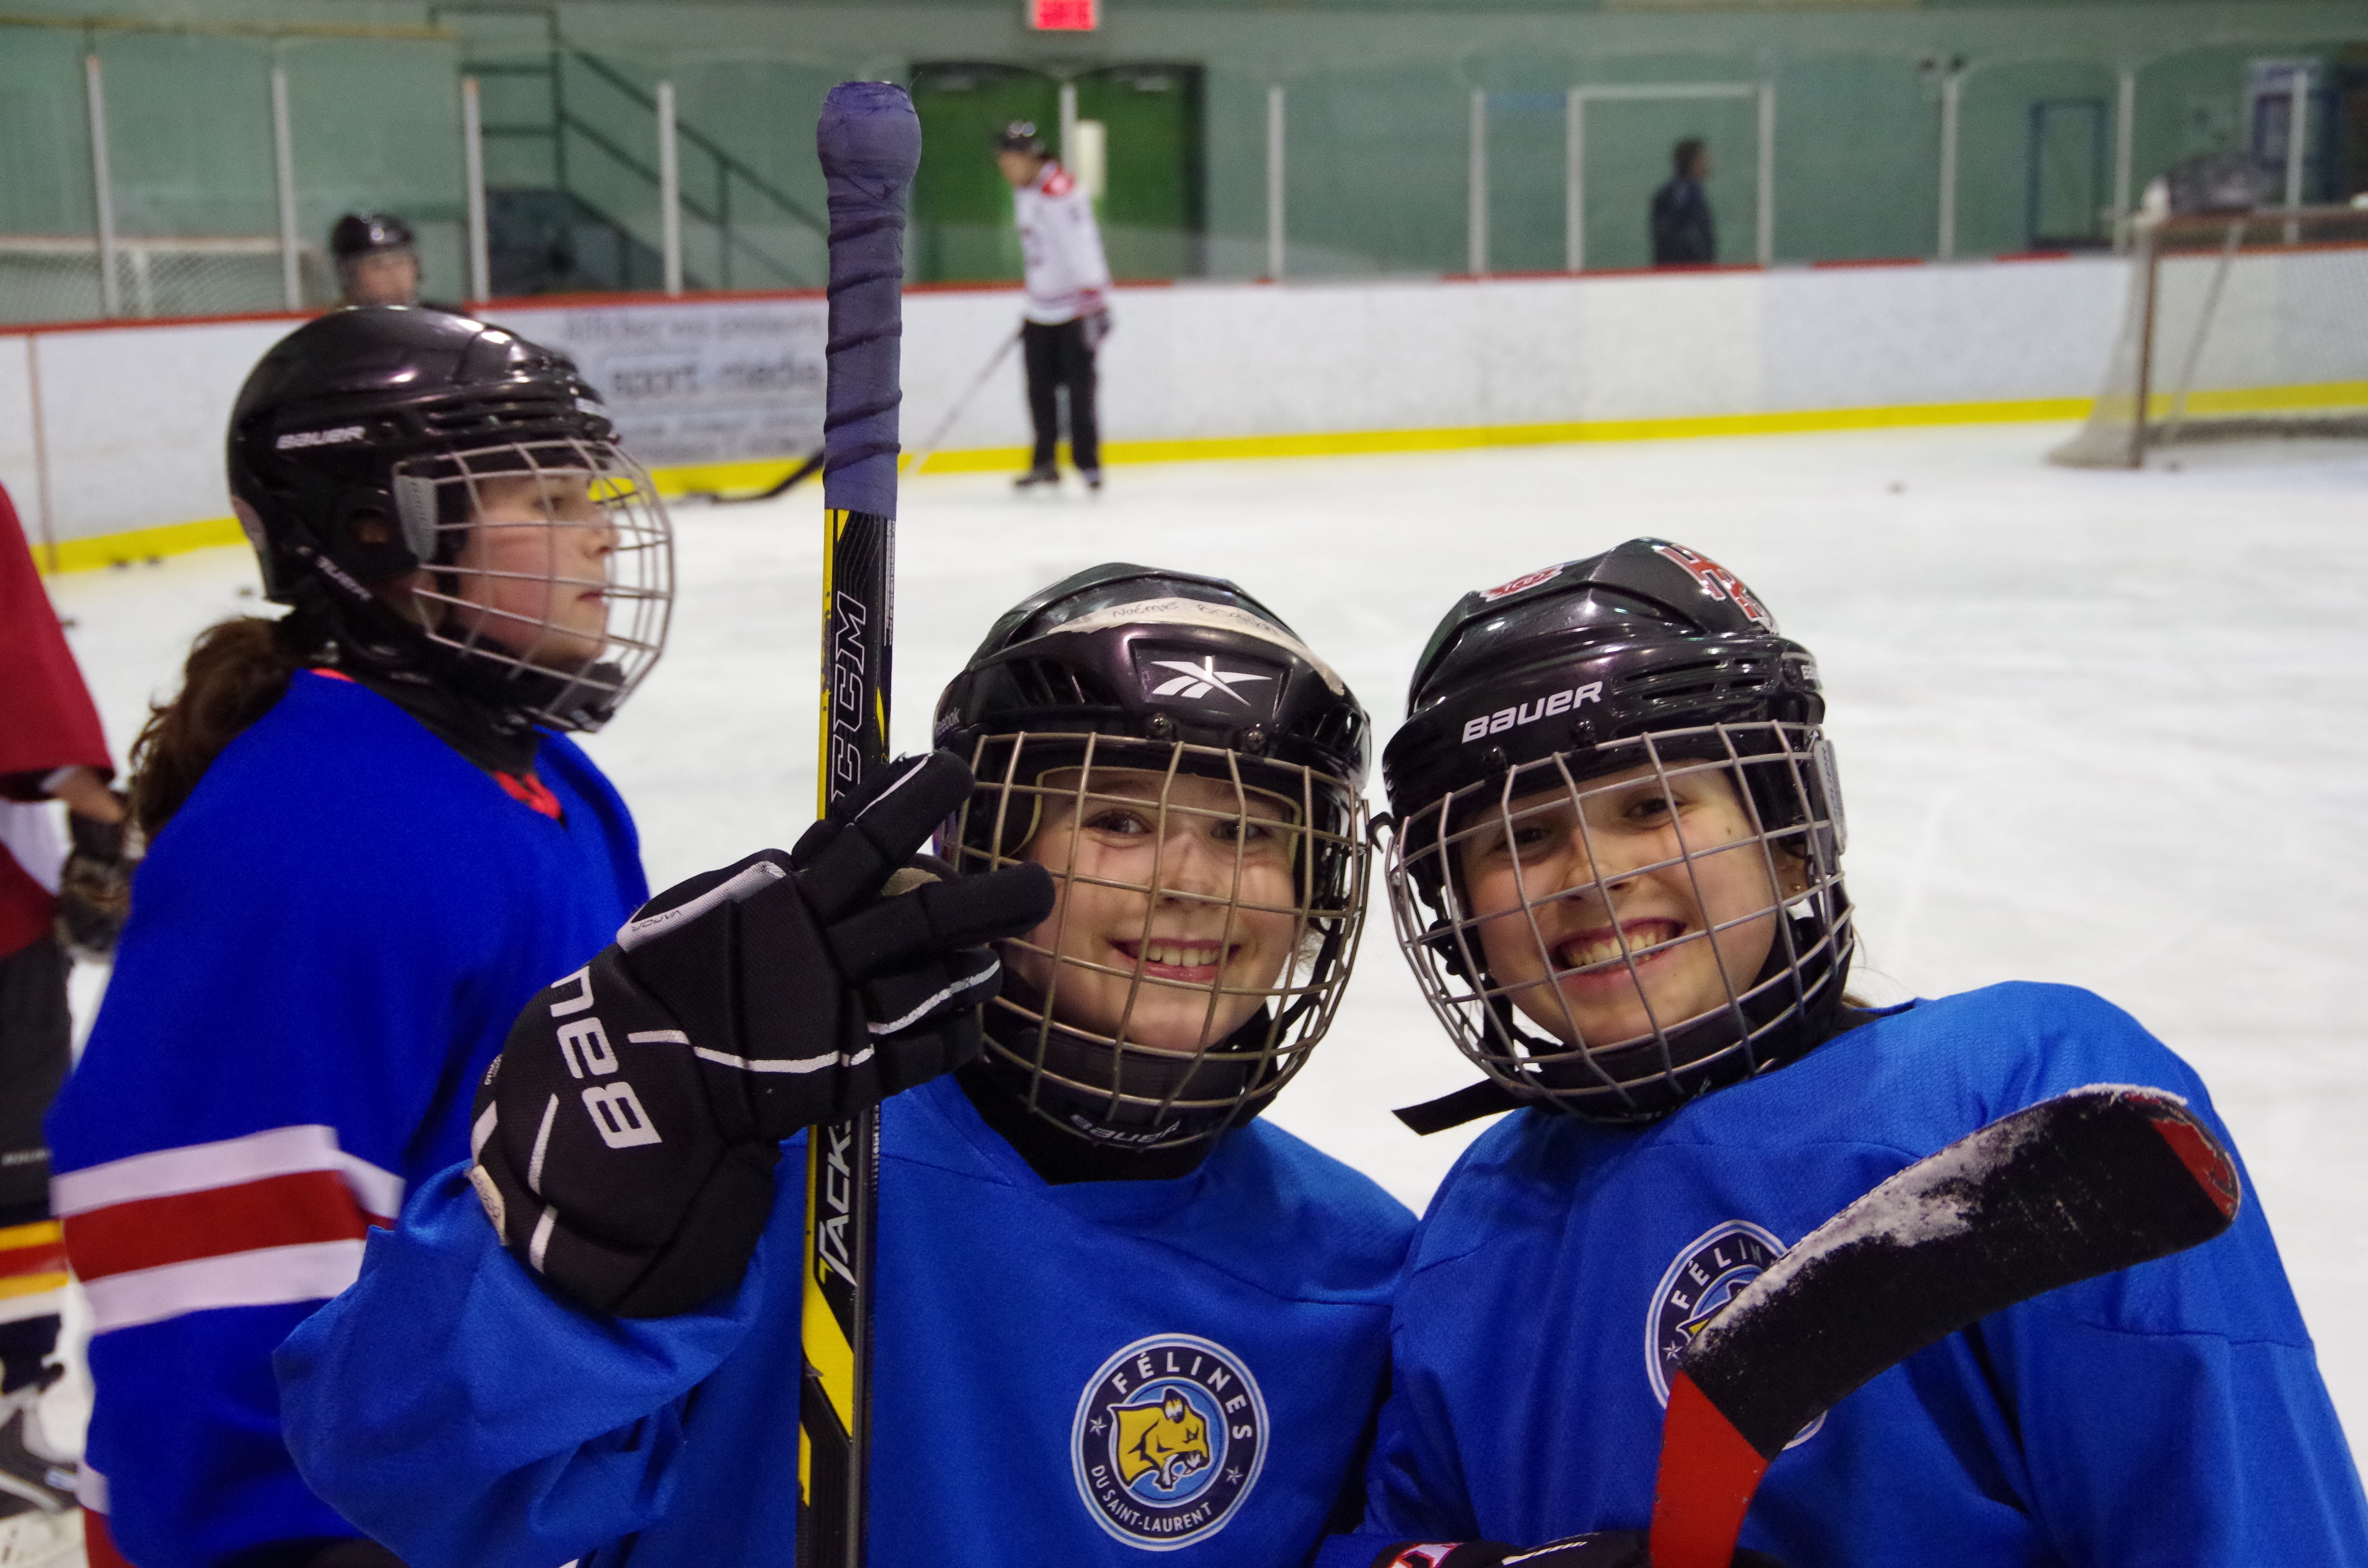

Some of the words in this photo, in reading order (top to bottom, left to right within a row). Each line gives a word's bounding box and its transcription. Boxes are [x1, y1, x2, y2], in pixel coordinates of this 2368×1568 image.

[831, 590, 866, 803] CCM
[1462, 681, 1603, 744] BAUER
[818, 1120, 859, 1287] TACK
[1111, 1351, 1252, 1440] FÉLINES
[1091, 1464, 1110, 1489] DU
[1102, 1489, 1213, 1532] SAINT-LAURENT
